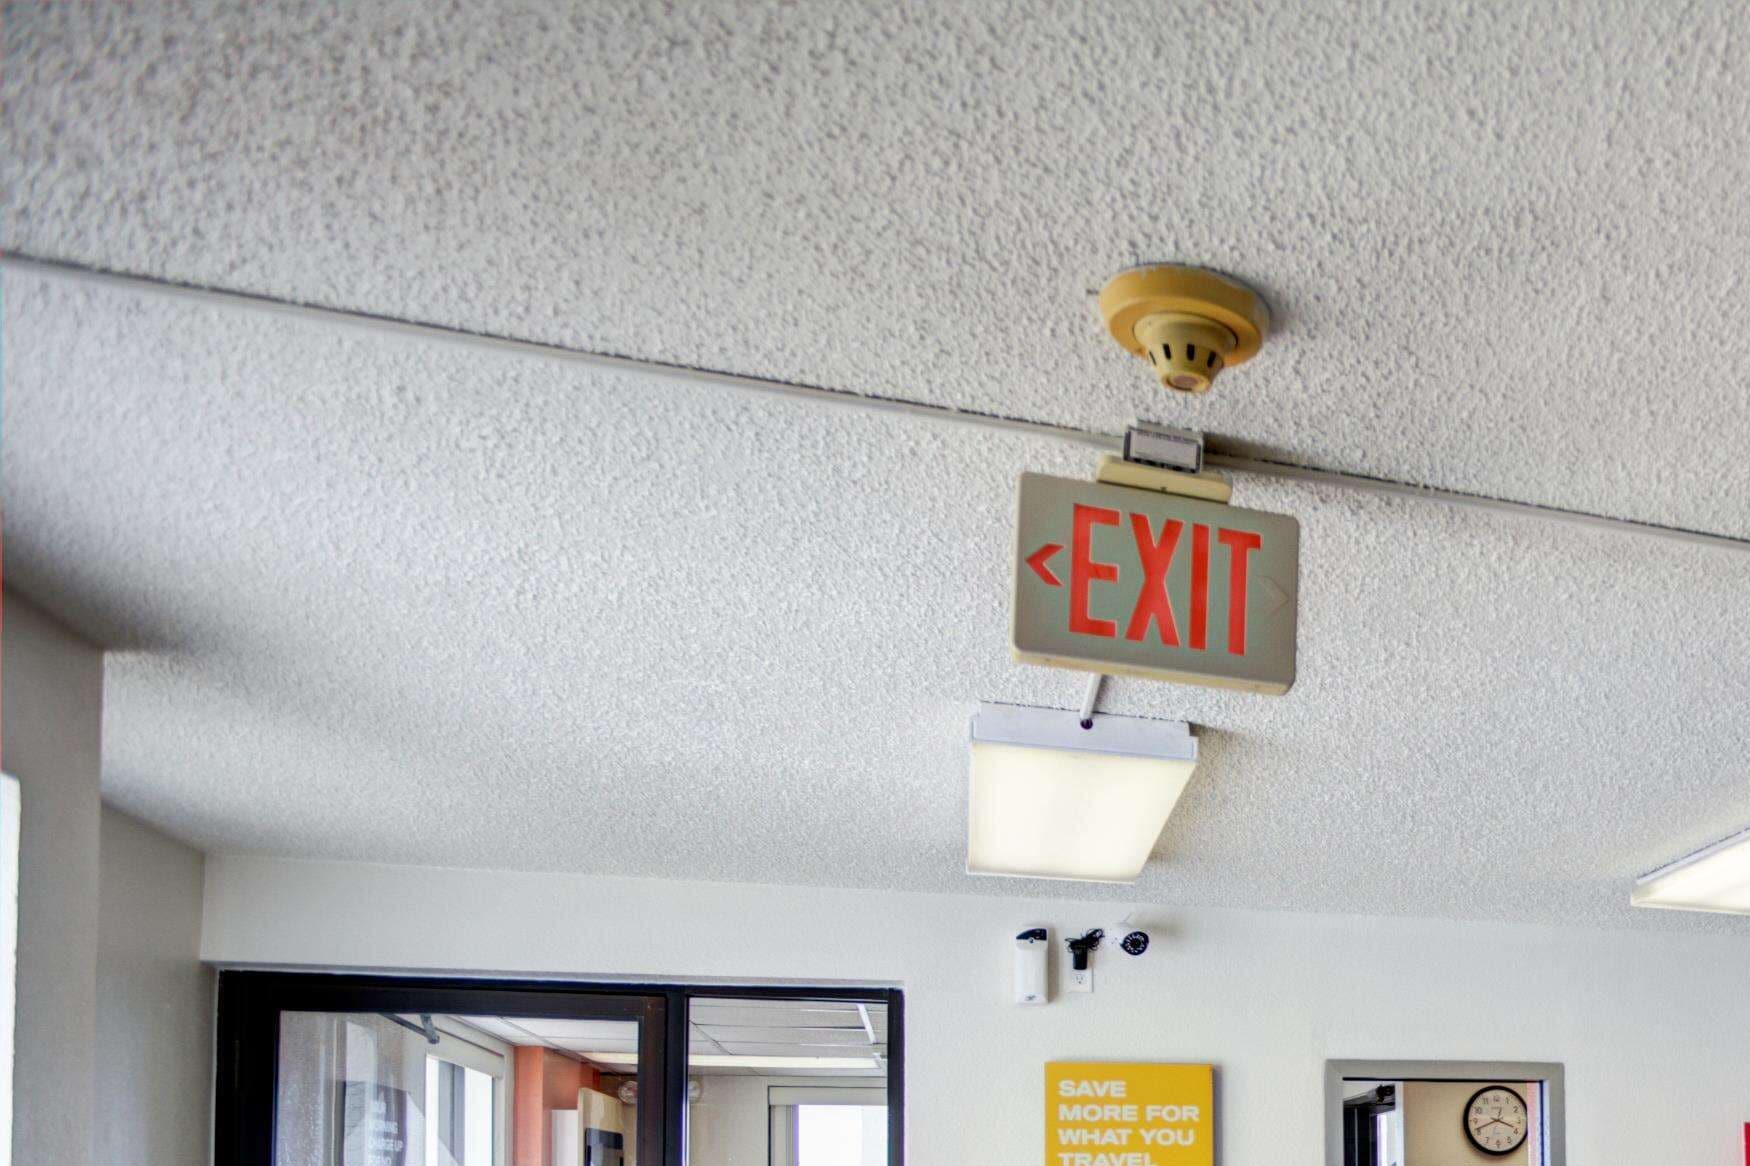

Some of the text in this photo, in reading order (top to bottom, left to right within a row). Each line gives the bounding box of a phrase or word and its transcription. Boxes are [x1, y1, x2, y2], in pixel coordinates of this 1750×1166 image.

[1068, 503, 1262, 656] EXIT
[1058, 1080, 1126, 1098] SAVE
[1058, 1104, 1200, 1122] MORE FOR
[1057, 1129, 1195, 1146] WHAT YOU
